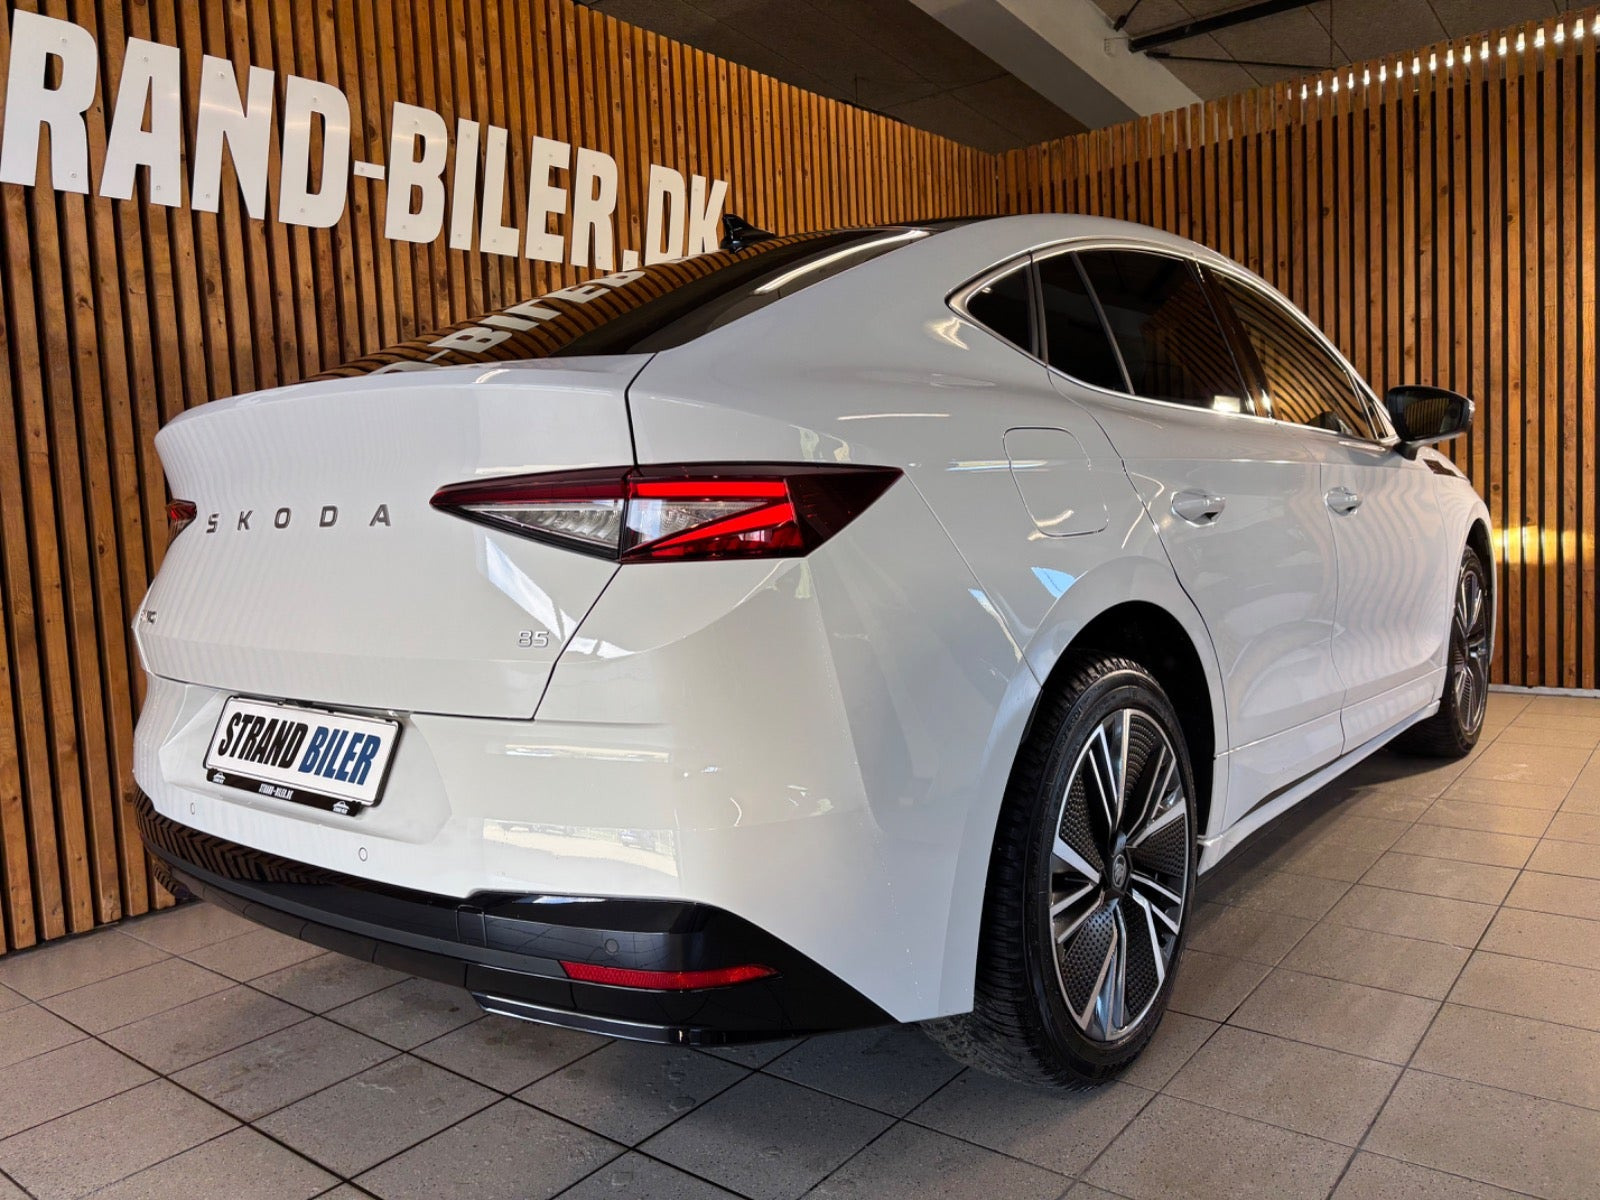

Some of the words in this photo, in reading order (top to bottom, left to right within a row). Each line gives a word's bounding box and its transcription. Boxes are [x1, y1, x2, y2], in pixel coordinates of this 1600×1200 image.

[0, 8, 728, 271] RAND-BILER.DK
[206, 504, 391, 533] SKODA
[518, 630, 549, 648] 85
[217, 712, 308, 769] STRAND
[298, 726, 381, 785] BILER
